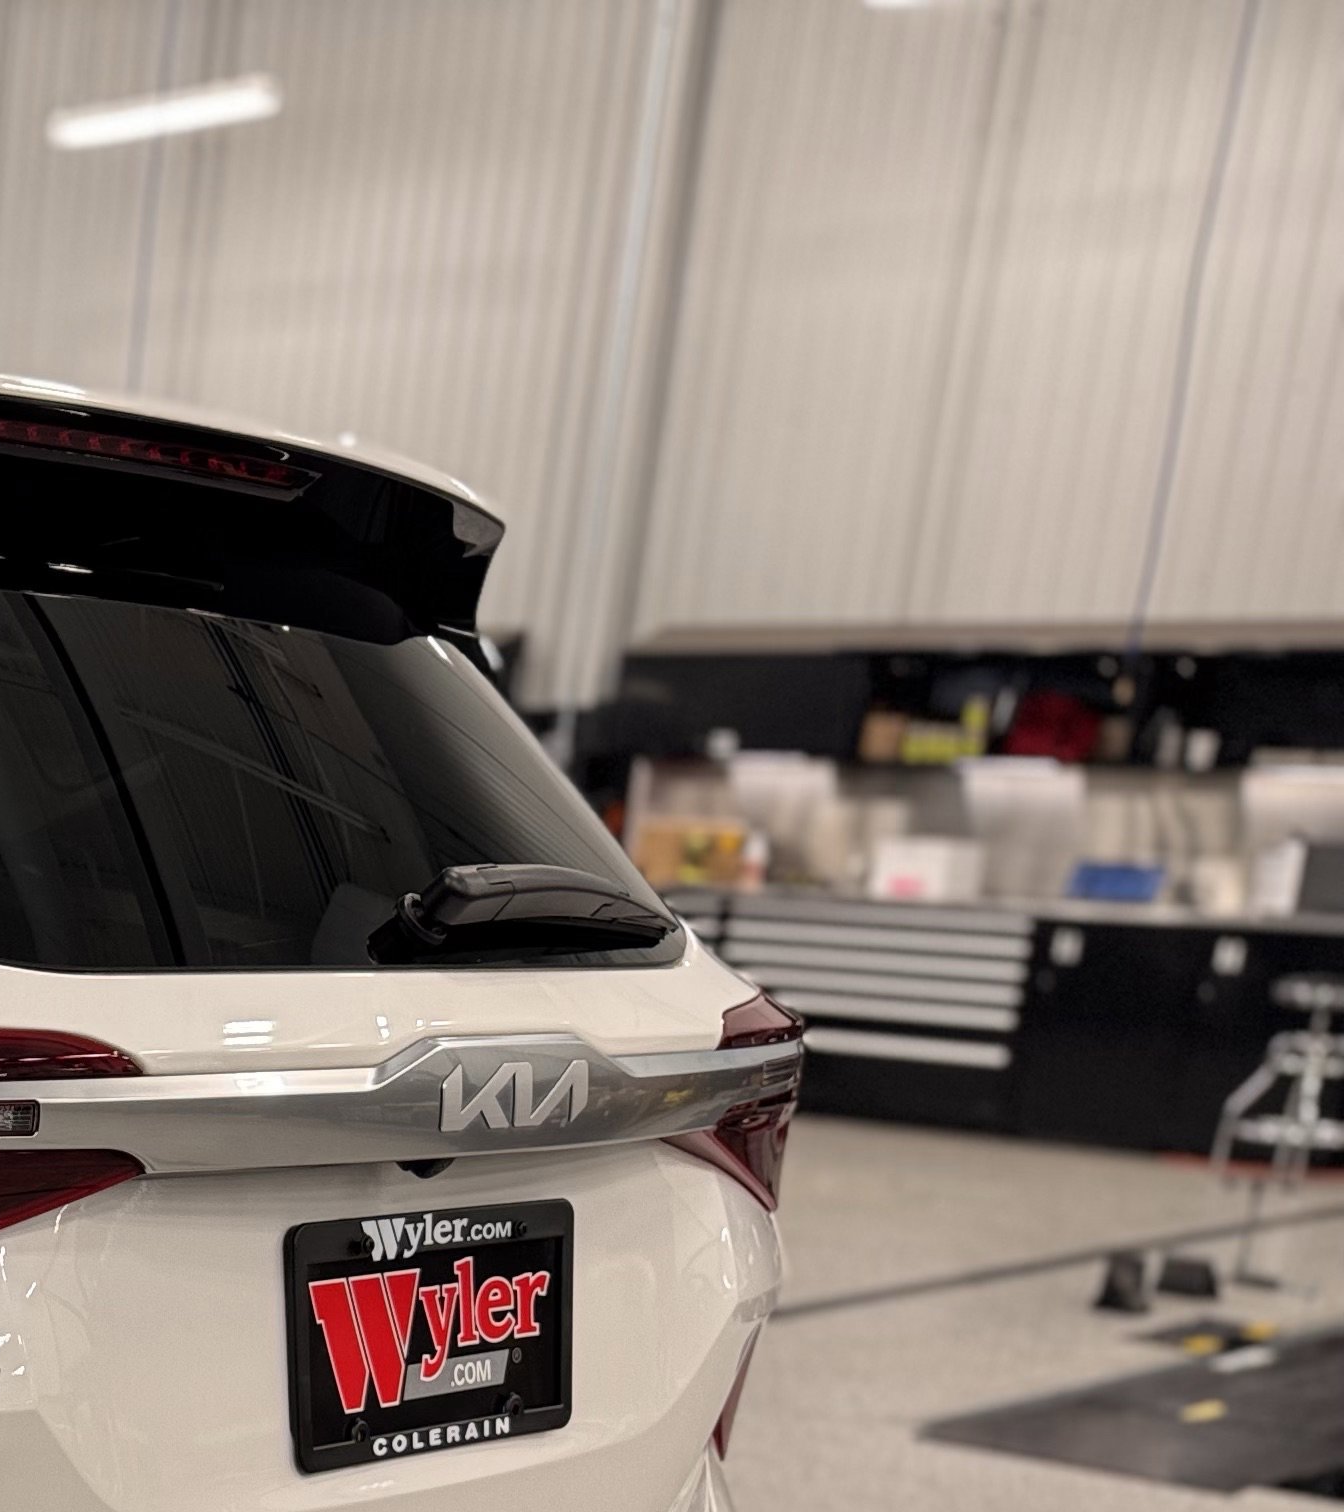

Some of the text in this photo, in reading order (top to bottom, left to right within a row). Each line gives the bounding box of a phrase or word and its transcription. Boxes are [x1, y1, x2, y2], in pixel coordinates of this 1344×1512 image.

[439, 1059, 589, 1132] KIA
[308, 1256, 551, 1415] Wyler
[450, 1359, 492, 1387] .COM
[372, 1416, 511, 1457] COLERAIN
